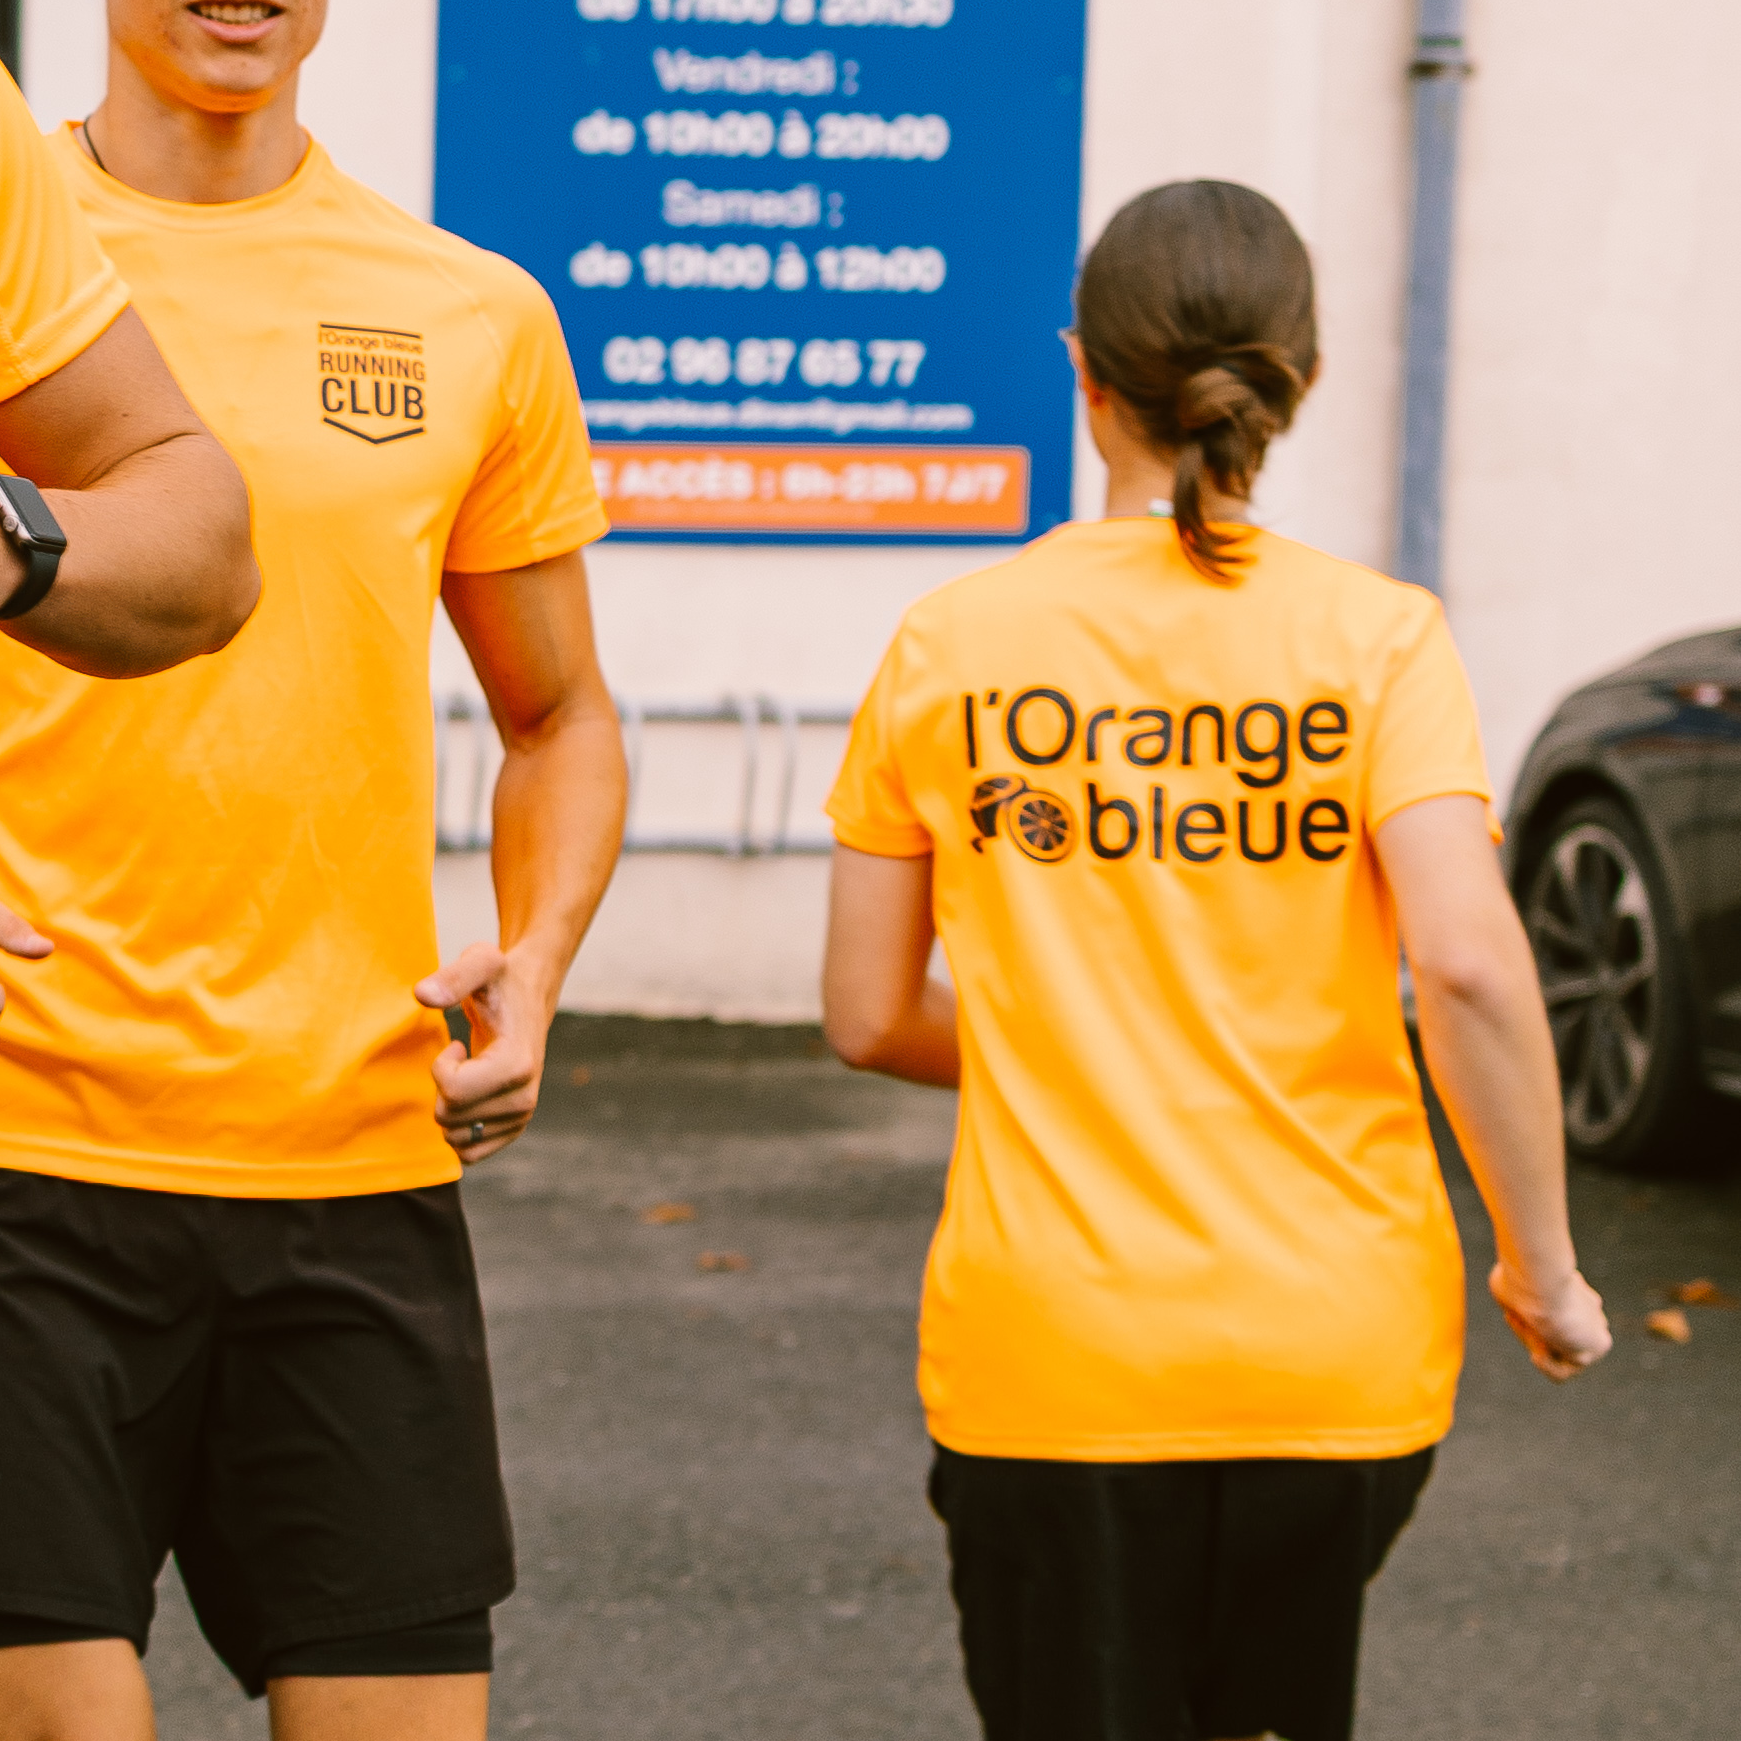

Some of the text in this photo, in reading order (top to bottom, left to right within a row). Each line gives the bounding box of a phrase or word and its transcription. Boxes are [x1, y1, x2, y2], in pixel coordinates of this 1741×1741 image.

[655, 50, 835, 95] Vendredi
[573, 110, 635, 154] de
[778, 110, 811, 157] à
[664, 180, 820, 227] Samedi
[570, 243, 631, 287] de
[774, 244, 807, 290] à
[319, 330, 423, 354] l'Orange bleue
[604, 337, 666, 383] 02
[868, 340, 925, 385] 77
[320, 352, 425, 381] RUNNING
[322, 378, 424, 420] CLUB
[965, 687, 1348, 789] l'Orange
[1086, 782, 1350, 863] bleue
